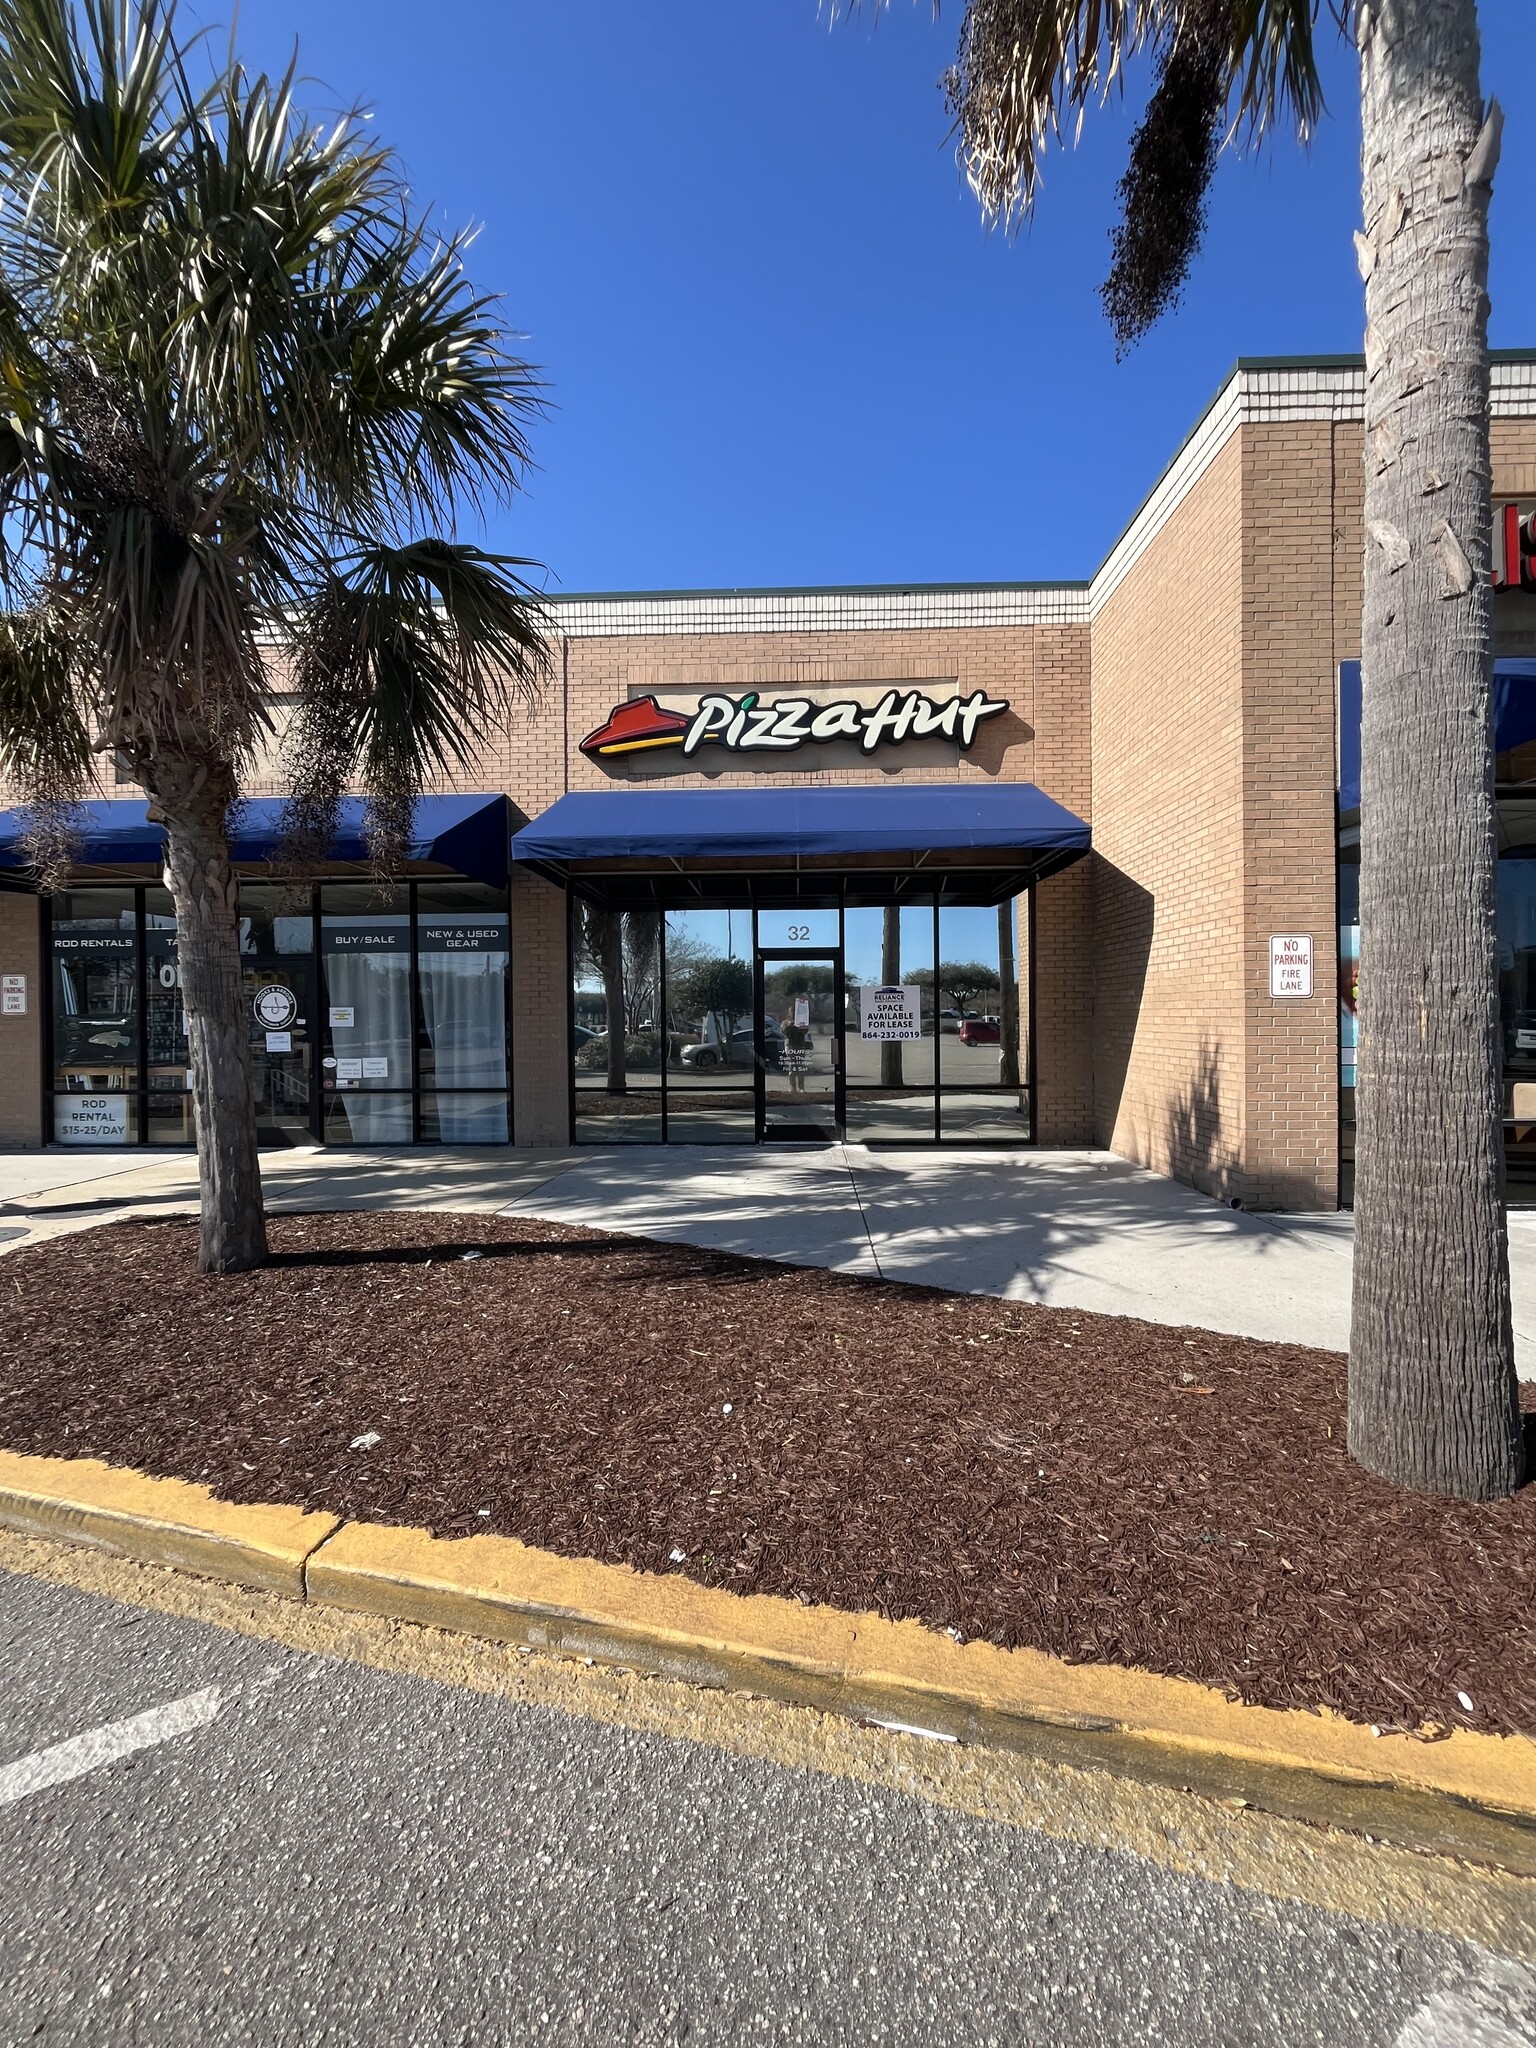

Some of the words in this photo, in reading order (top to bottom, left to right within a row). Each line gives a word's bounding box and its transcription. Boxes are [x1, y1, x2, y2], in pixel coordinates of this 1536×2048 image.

[683, 692, 862, 755] Pizza
[861, 691, 1006, 749] Hut
[426, 930, 453, 938] NEW
[455, 930, 464, 938] &
[467, 930, 499, 938] USED
[787, 925, 810, 941] 32
[54, 940, 79, 948] ROD
[80, 939, 133, 947] RENTALS
[335, 935, 396, 944] BUY/SALE
[446, 939, 479, 948] GEAR
[1283, 940, 1299, 952] NO
[1274, 953, 1309, 965] PARKING
[1281, 969, 1301, 979] FIRE
[1280, 981, 1303, 990] LANE
[877, 1004, 904, 1012] SPACE
[867, 1012, 914, 1021] AVAILABLE
[868, 1021, 886, 1029] FOR
[862, 1031, 920, 1039] 864-232-0019
[81, 1100, 107, 1109] ROD
[72, 1113, 116, 1122] RENTAL
[61, 1125, 126, 1136] $15-25/DAY
